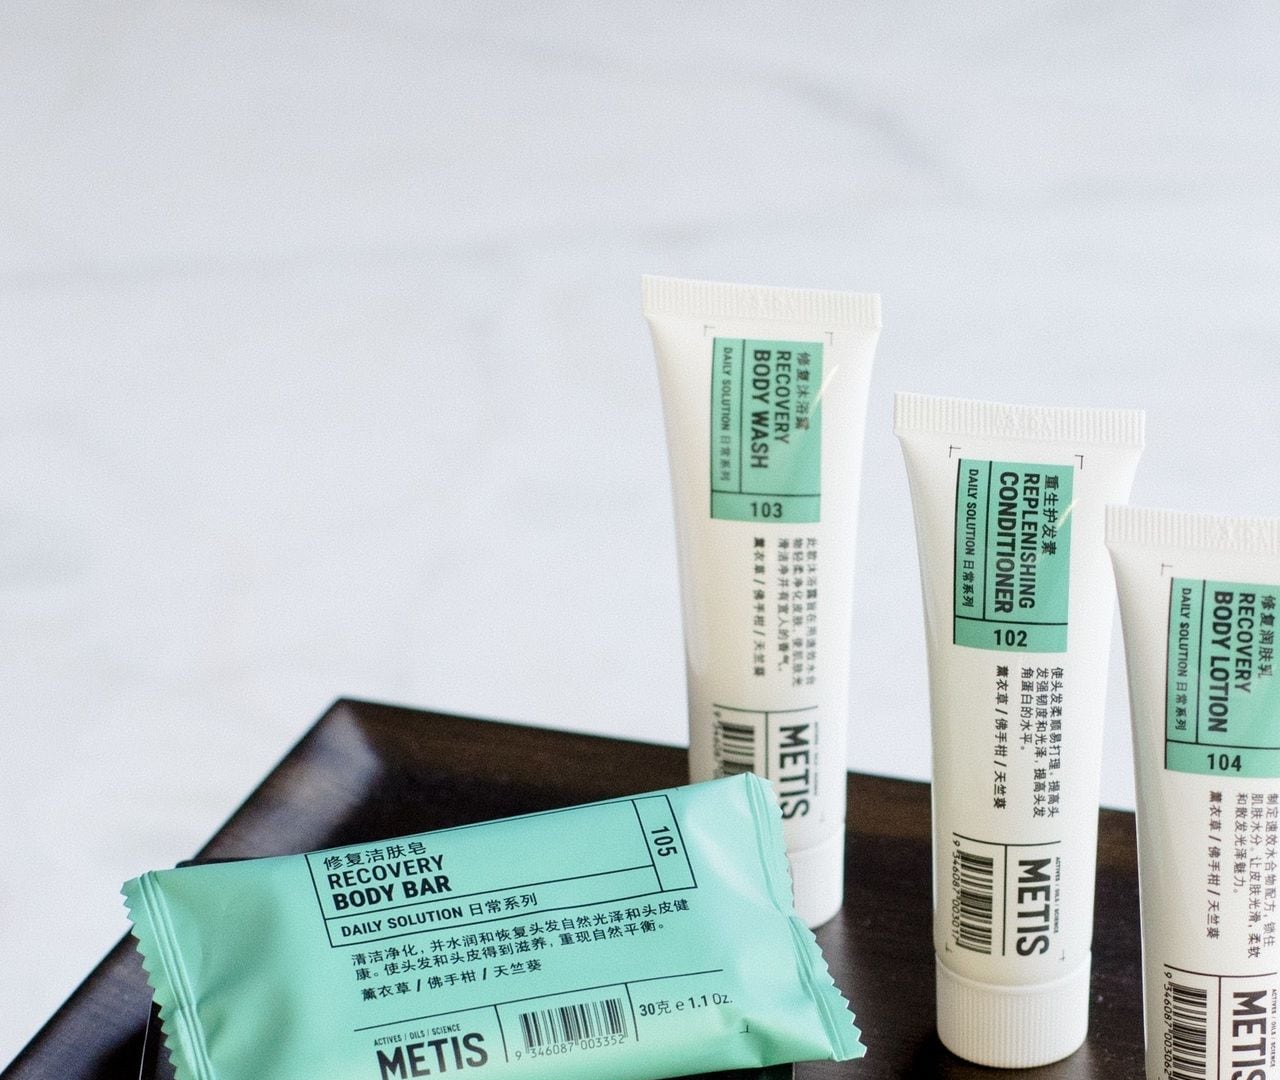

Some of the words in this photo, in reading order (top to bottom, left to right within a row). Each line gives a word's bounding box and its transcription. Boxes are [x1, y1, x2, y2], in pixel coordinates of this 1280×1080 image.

[722, 347, 733, 375] DAILY
[752, 350, 770, 404] BODY
[721, 379, 731, 430] SOLUTION
[774, 351, 791, 444] RECOVERY
[795, 352, 810, 430] 修复沐浴露
[720, 436, 731, 481] 日常系列
[751, 411, 769, 469] WASH
[968, 469, 979, 499] DAILY
[751, 502, 783, 519] 103
[965, 502, 977, 555] SOLUTION
[1042, 475, 1058, 555] 重生护发素
[995, 472, 1019, 613] CONDITIONER
[1019, 473, 1040, 609] REPLENISHING
[962, 560, 974, 607] 日常系列
[1180, 588, 1192, 619] DAILY
[994, 630, 1027, 647] 102
[1213, 591, 1232, 650] BODY
[1258, 595, 1276, 679] 修复润肤乳
[1177, 622, 1189, 677] SOLUTION
[1235, 593, 1255, 694] RECOVERY
[996, 666, 1009, 704] 薰衣草
[1175, 682, 1188, 731] 日常系列
[1208, 656, 1229, 733] LOTION
[1020, 667, 1033, 750] 角蛋白的水平。
[995, 719, 1007, 757] 佛手柑
[779, 723, 810, 820] METIS
[1207, 753, 1242, 772] 104
[994, 771, 1006, 809] 天竺葵
[1209, 791, 1222, 831] 薰衣草
[323, 842, 427, 871] 修复洁肤皂
[651, 825, 677, 857] 105
[1233, 793, 1248, 894] 和散发光泽魅力。
[328, 855, 444, 890] RECOVERY
[952, 852, 960, 895] 346087
[1208, 846, 1221, 885] 佛手柑
[332, 884, 395, 911] BODY
[402, 875, 451, 898] BAR
[341, 920, 383, 937] DAILY
[387, 906, 463, 930] SOLUTION
[470, 892, 538, 917] 日常系列
[1016, 858, 1051, 956] METIS
[1207, 900, 1219, 939] 天竺葵
[361, 980, 411, 1001] 薰衣草
[427, 970, 476, 990] 佛手柑
[494, 959, 542, 978] 天竺葵
[639, 1001, 670, 1017] 30克
[688, 995, 708, 1009] 1.1
[712, 993, 733, 1005] Oz.
[1164, 984, 1172, 1028] 346087
[374, 1035, 402, 1046] ACTIVES
[409, 1030, 424, 1040] OILS
[432, 1023, 461, 1036] SCIENCE
[515, 1051, 522, 1061] 9
[530, 1042, 574, 1059] 346087
[580, 1035, 625, 1050] 003352
[1164, 1032, 1172, 1076] 003062
